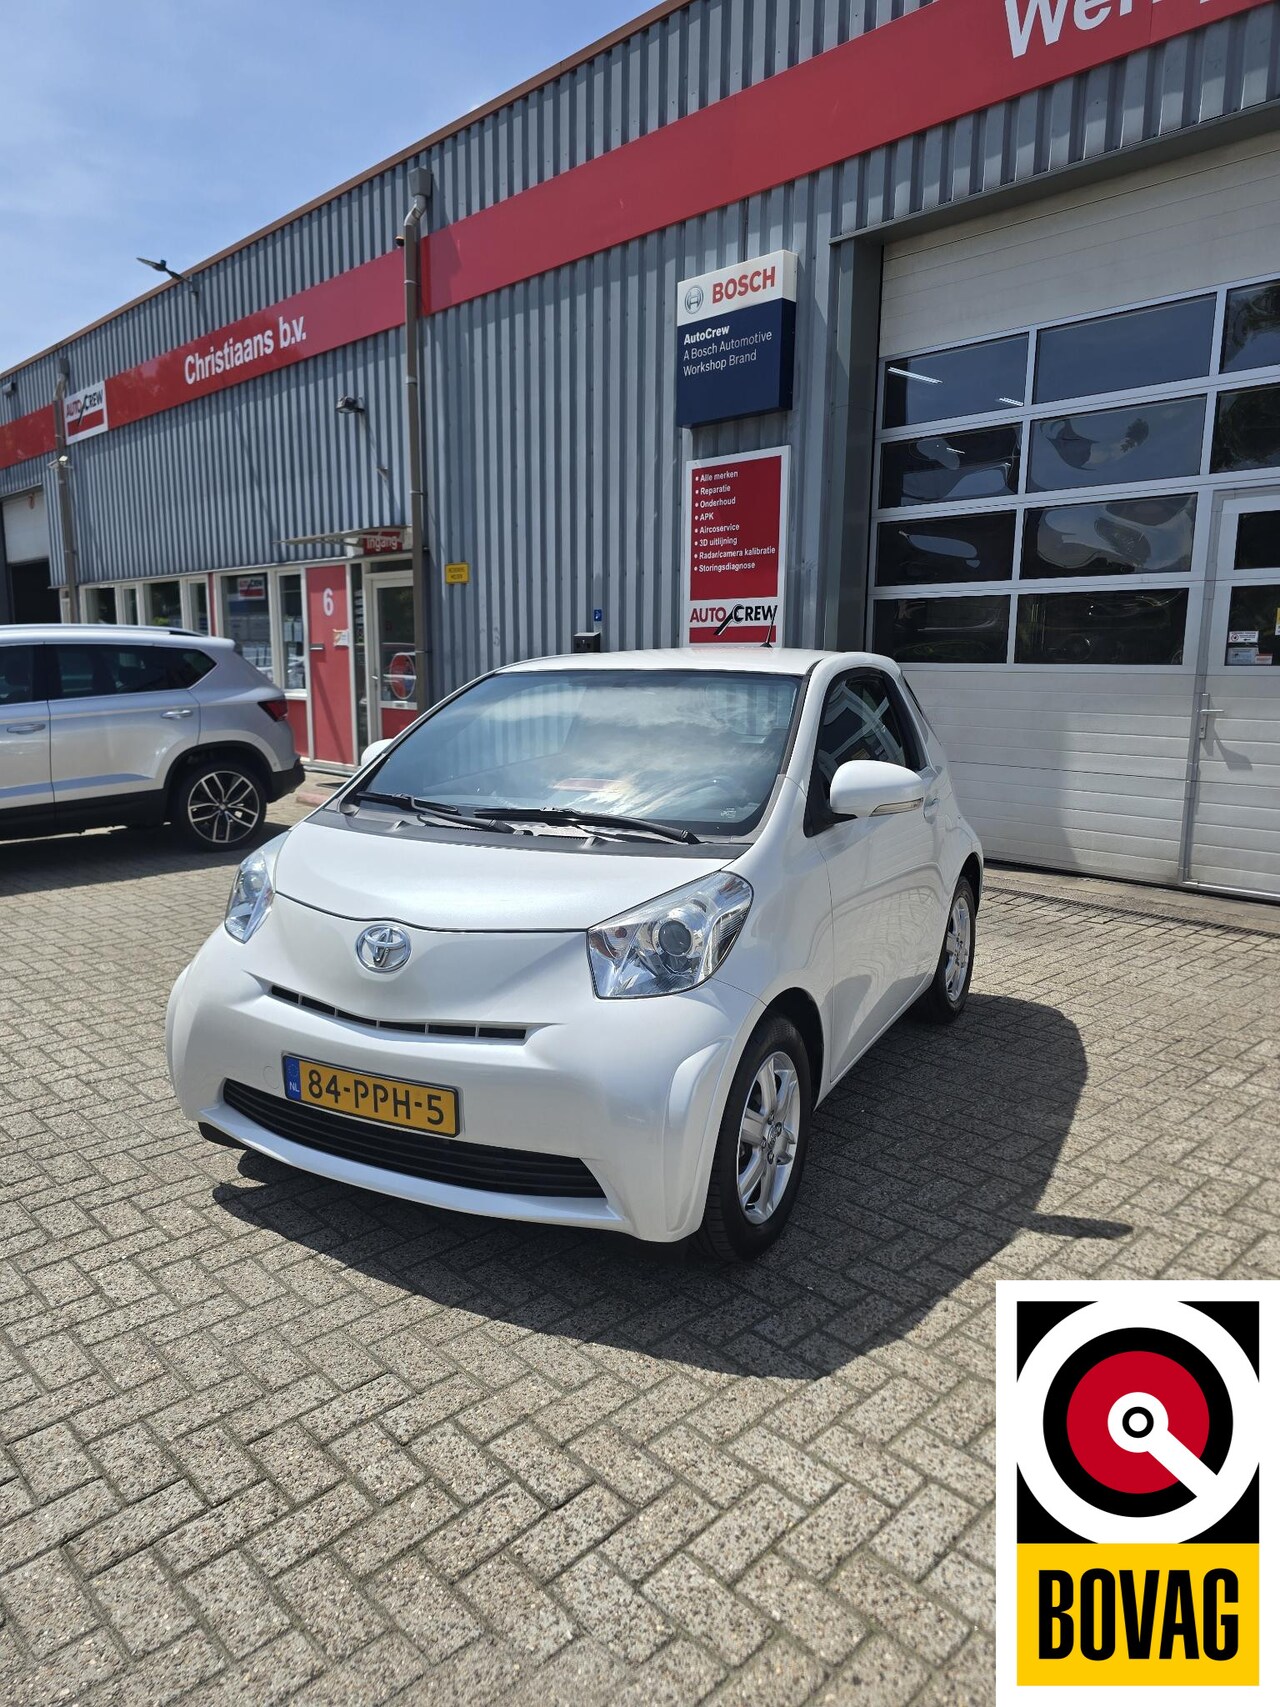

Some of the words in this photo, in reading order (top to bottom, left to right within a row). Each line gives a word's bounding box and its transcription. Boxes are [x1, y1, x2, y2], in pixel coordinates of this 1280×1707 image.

[712, 266, 776, 304] BOSCH
[683, 325, 730, 346] AutoCrew
[184, 328, 274, 385] Christiaans
[278, 316, 307, 349] b.v.
[683, 350, 690, 361] A
[691, 343, 718, 358] Bosch
[719, 331, 773, 351] Automotive
[683, 358, 727, 377] Workshop
[729, 349, 757, 366] Brand
[700, 473, 713, 483] Alle
[714, 470, 739, 481] merken
[700, 484, 731, 497] Reparatie
[700, 497, 736, 508] Onderhoud
[699, 512, 714, 521] APK
[699, 524, 740, 534] Aircoservice
[699, 538, 708, 547] 3D
[709, 536, 738, 548] uitlijning
[699, 549, 743, 560] Radar/camera
[744, 546, 776, 556] kalibratie
[699, 561, 756, 573] Storingsdiagnose
[322, 588, 334, 616] 6
[690, 607, 727, 623] AUTO
[733, 605, 777, 622] CREW
[289, 1082, 300, 1093] NL
[308, 1069, 444, 1125] 84-PPH-5
